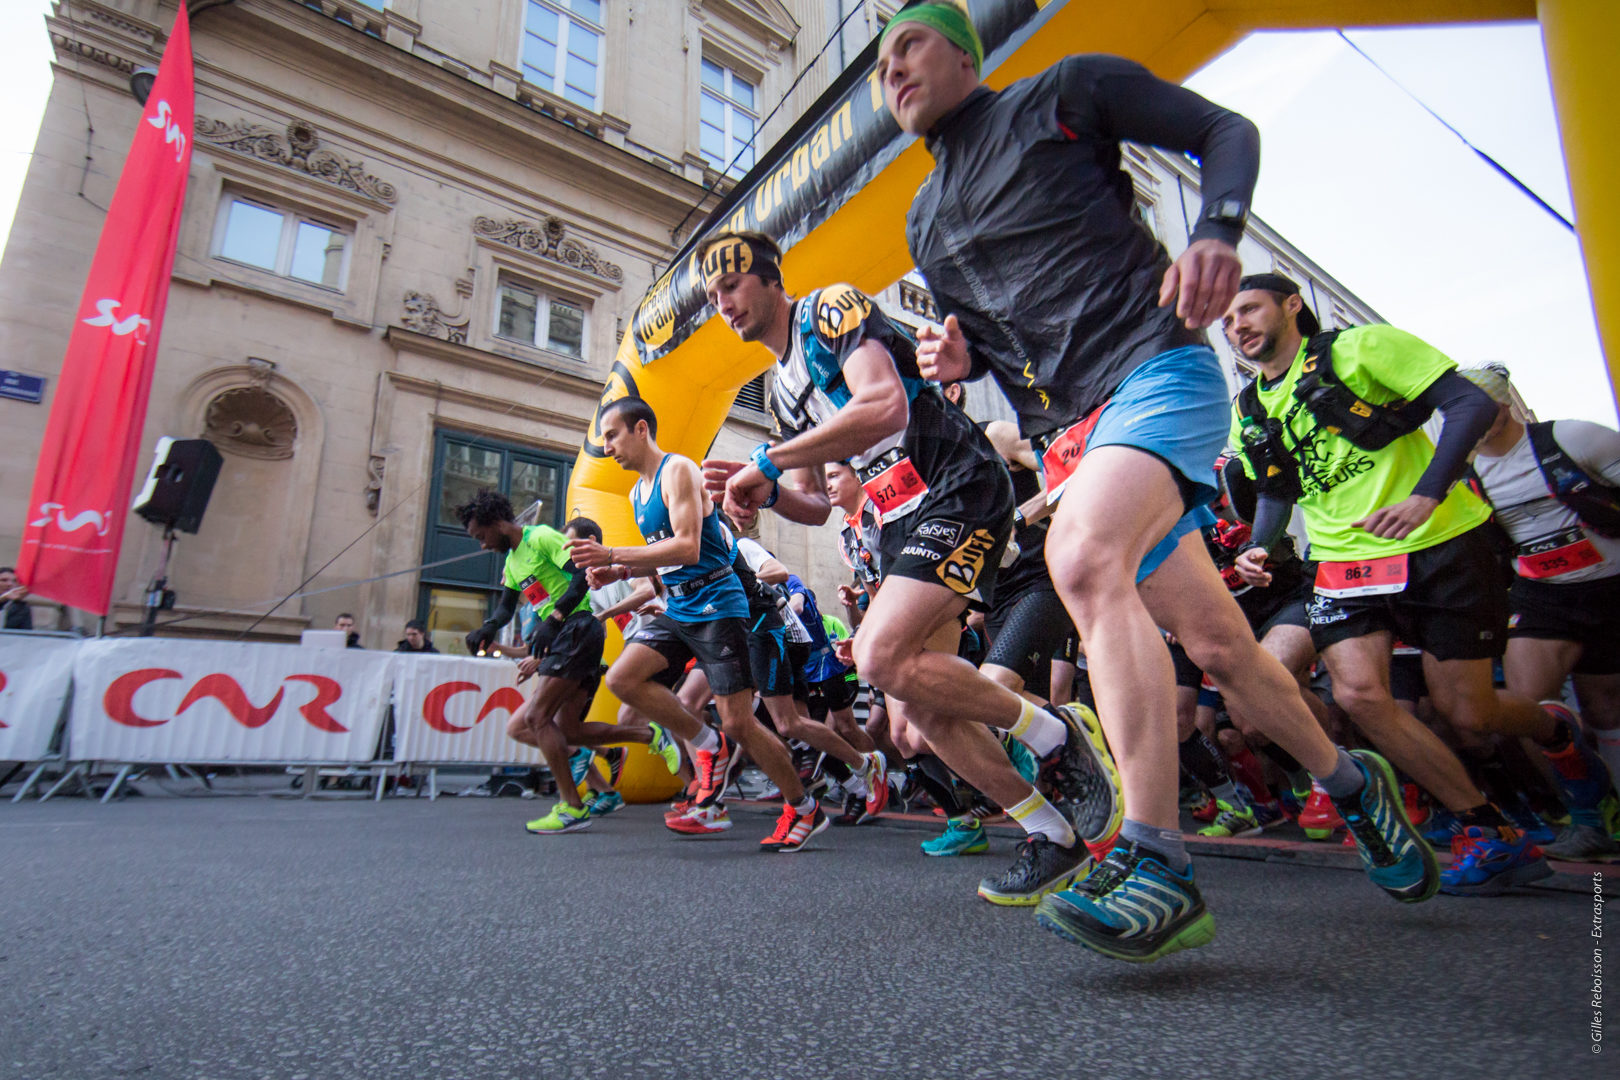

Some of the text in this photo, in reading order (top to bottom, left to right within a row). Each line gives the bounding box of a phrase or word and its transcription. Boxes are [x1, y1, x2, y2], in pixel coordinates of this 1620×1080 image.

[1062, 440, 1082, 467] 20
[876, 484, 897, 504] 573
[901, 545, 941, 561] SUUNTO
[1345, 565, 1372, 580] 862
[1539, 556, 1569, 572] 335
[104, 668, 349, 733] CNR
